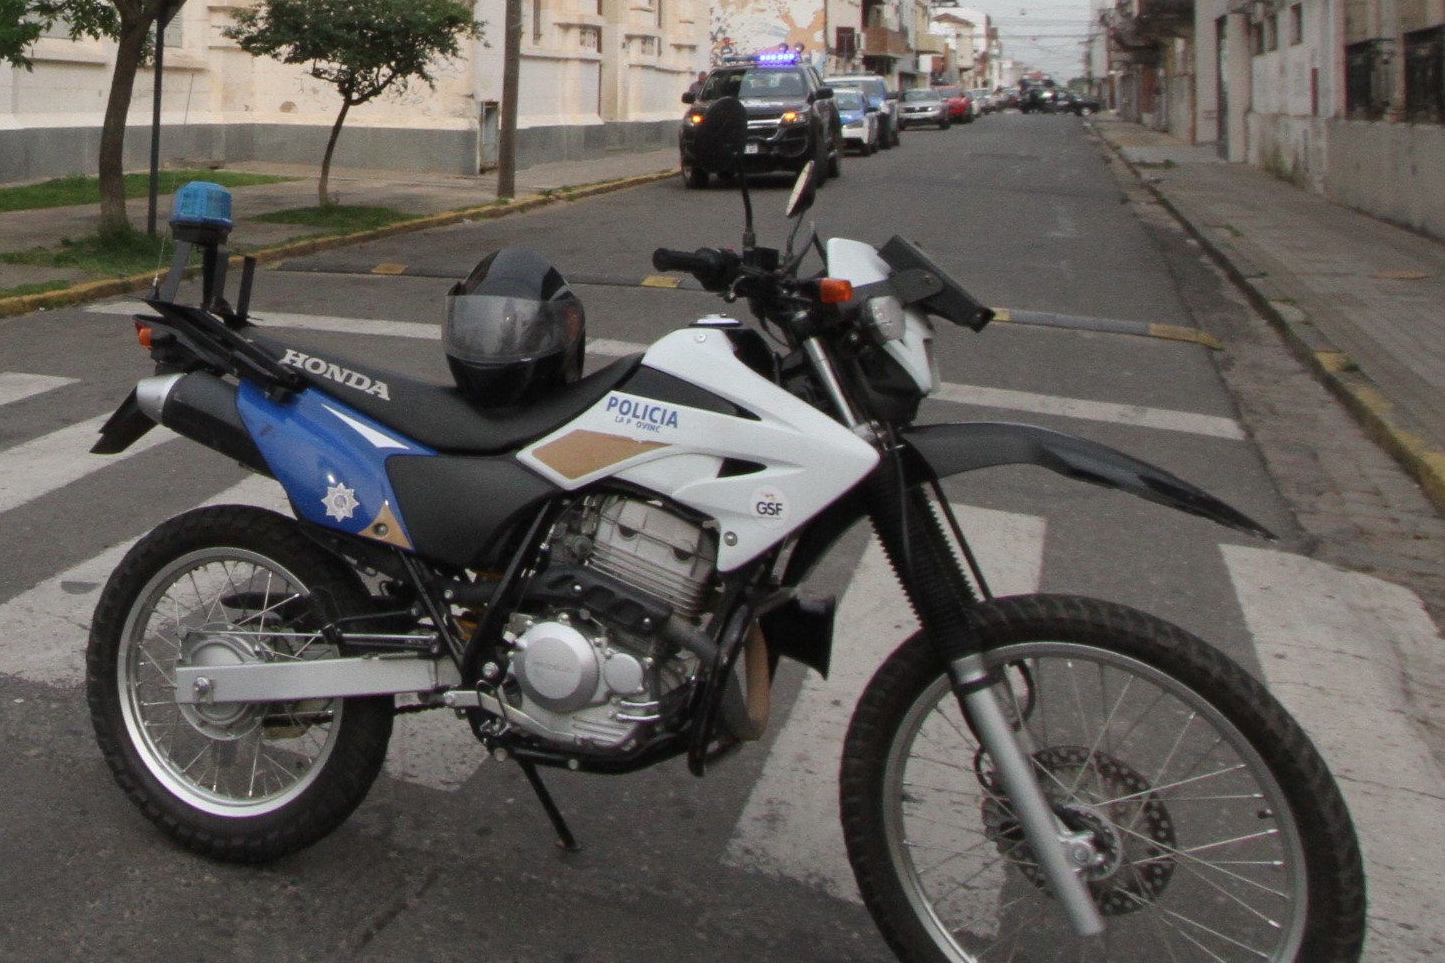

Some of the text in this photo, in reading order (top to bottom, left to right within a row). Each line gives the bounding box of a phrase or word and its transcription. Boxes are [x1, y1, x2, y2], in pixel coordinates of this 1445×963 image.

[278, 348, 391, 402] HONDA
[606, 396, 679, 429] POLICIA
[756, 501, 783, 516] GSF
